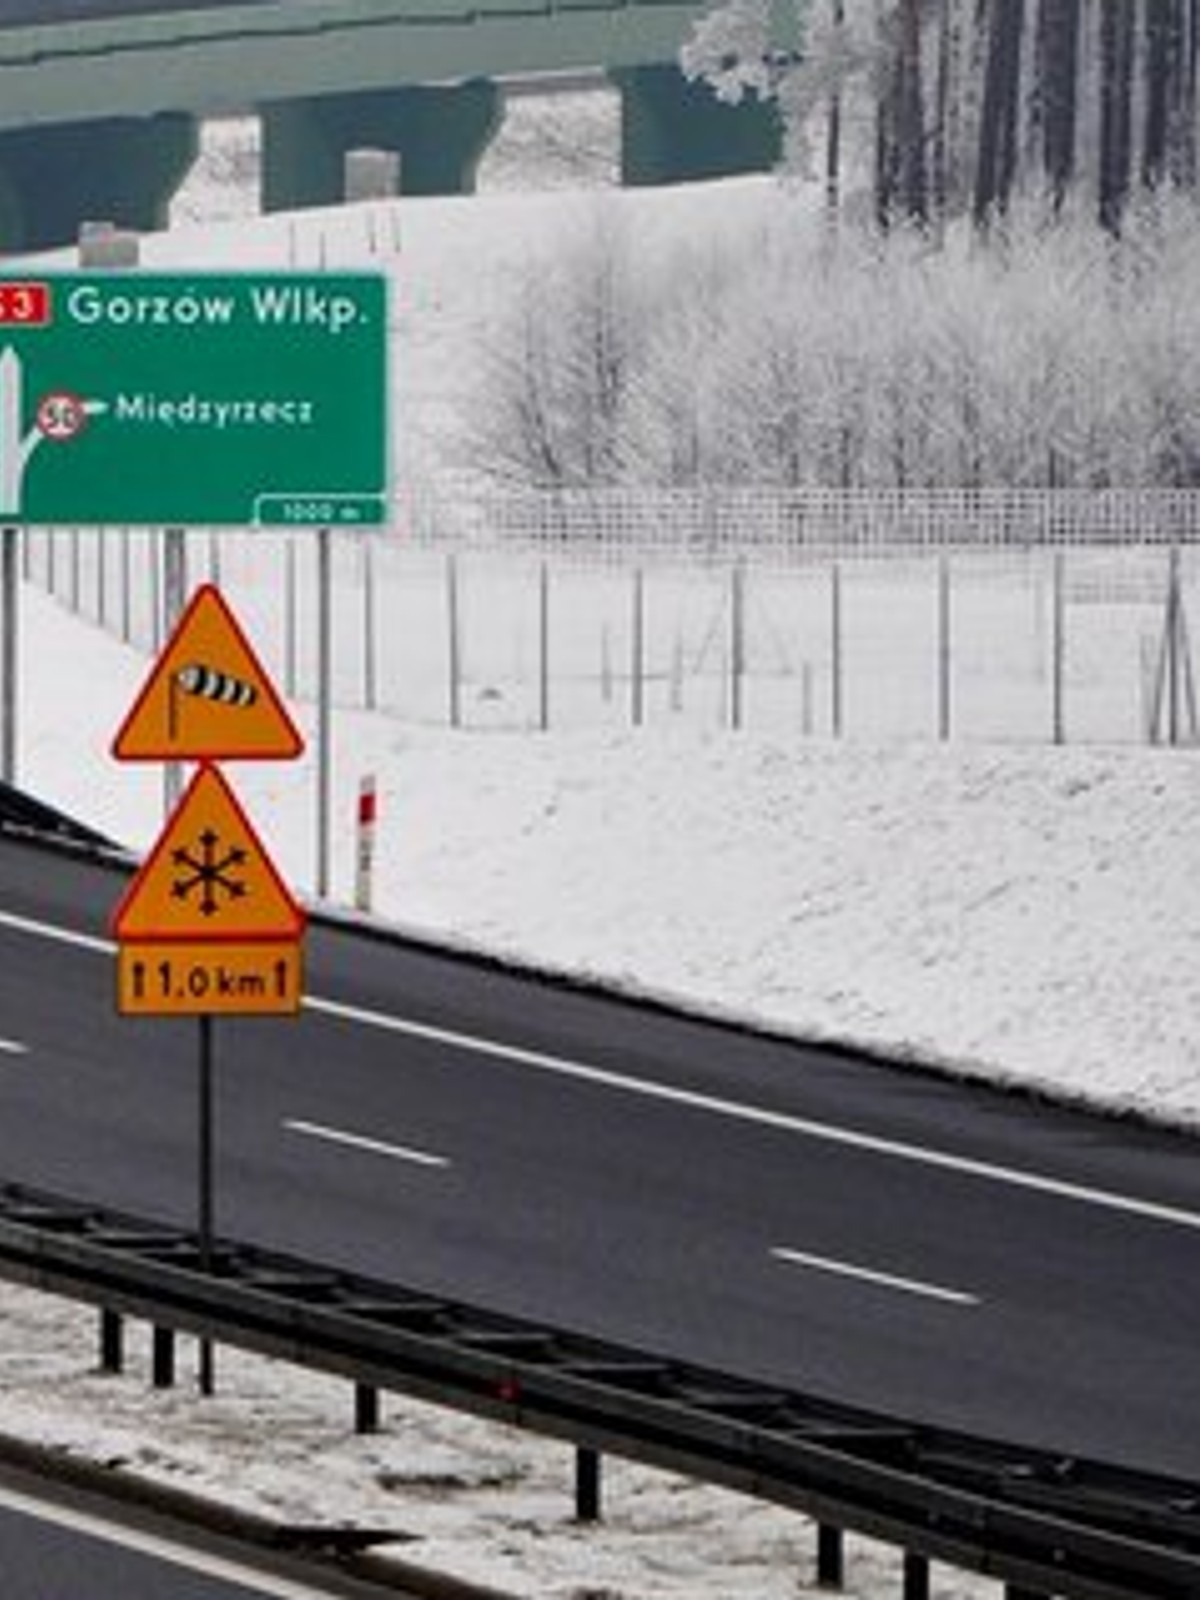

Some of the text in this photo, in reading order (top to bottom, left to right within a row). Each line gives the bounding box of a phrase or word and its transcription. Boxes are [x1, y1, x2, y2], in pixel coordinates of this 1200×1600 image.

[68, 285, 370, 334] Gorzów Wlkp.
[116, 392, 312, 428] Międzyrzecz
[216, 966, 265, 996] km
